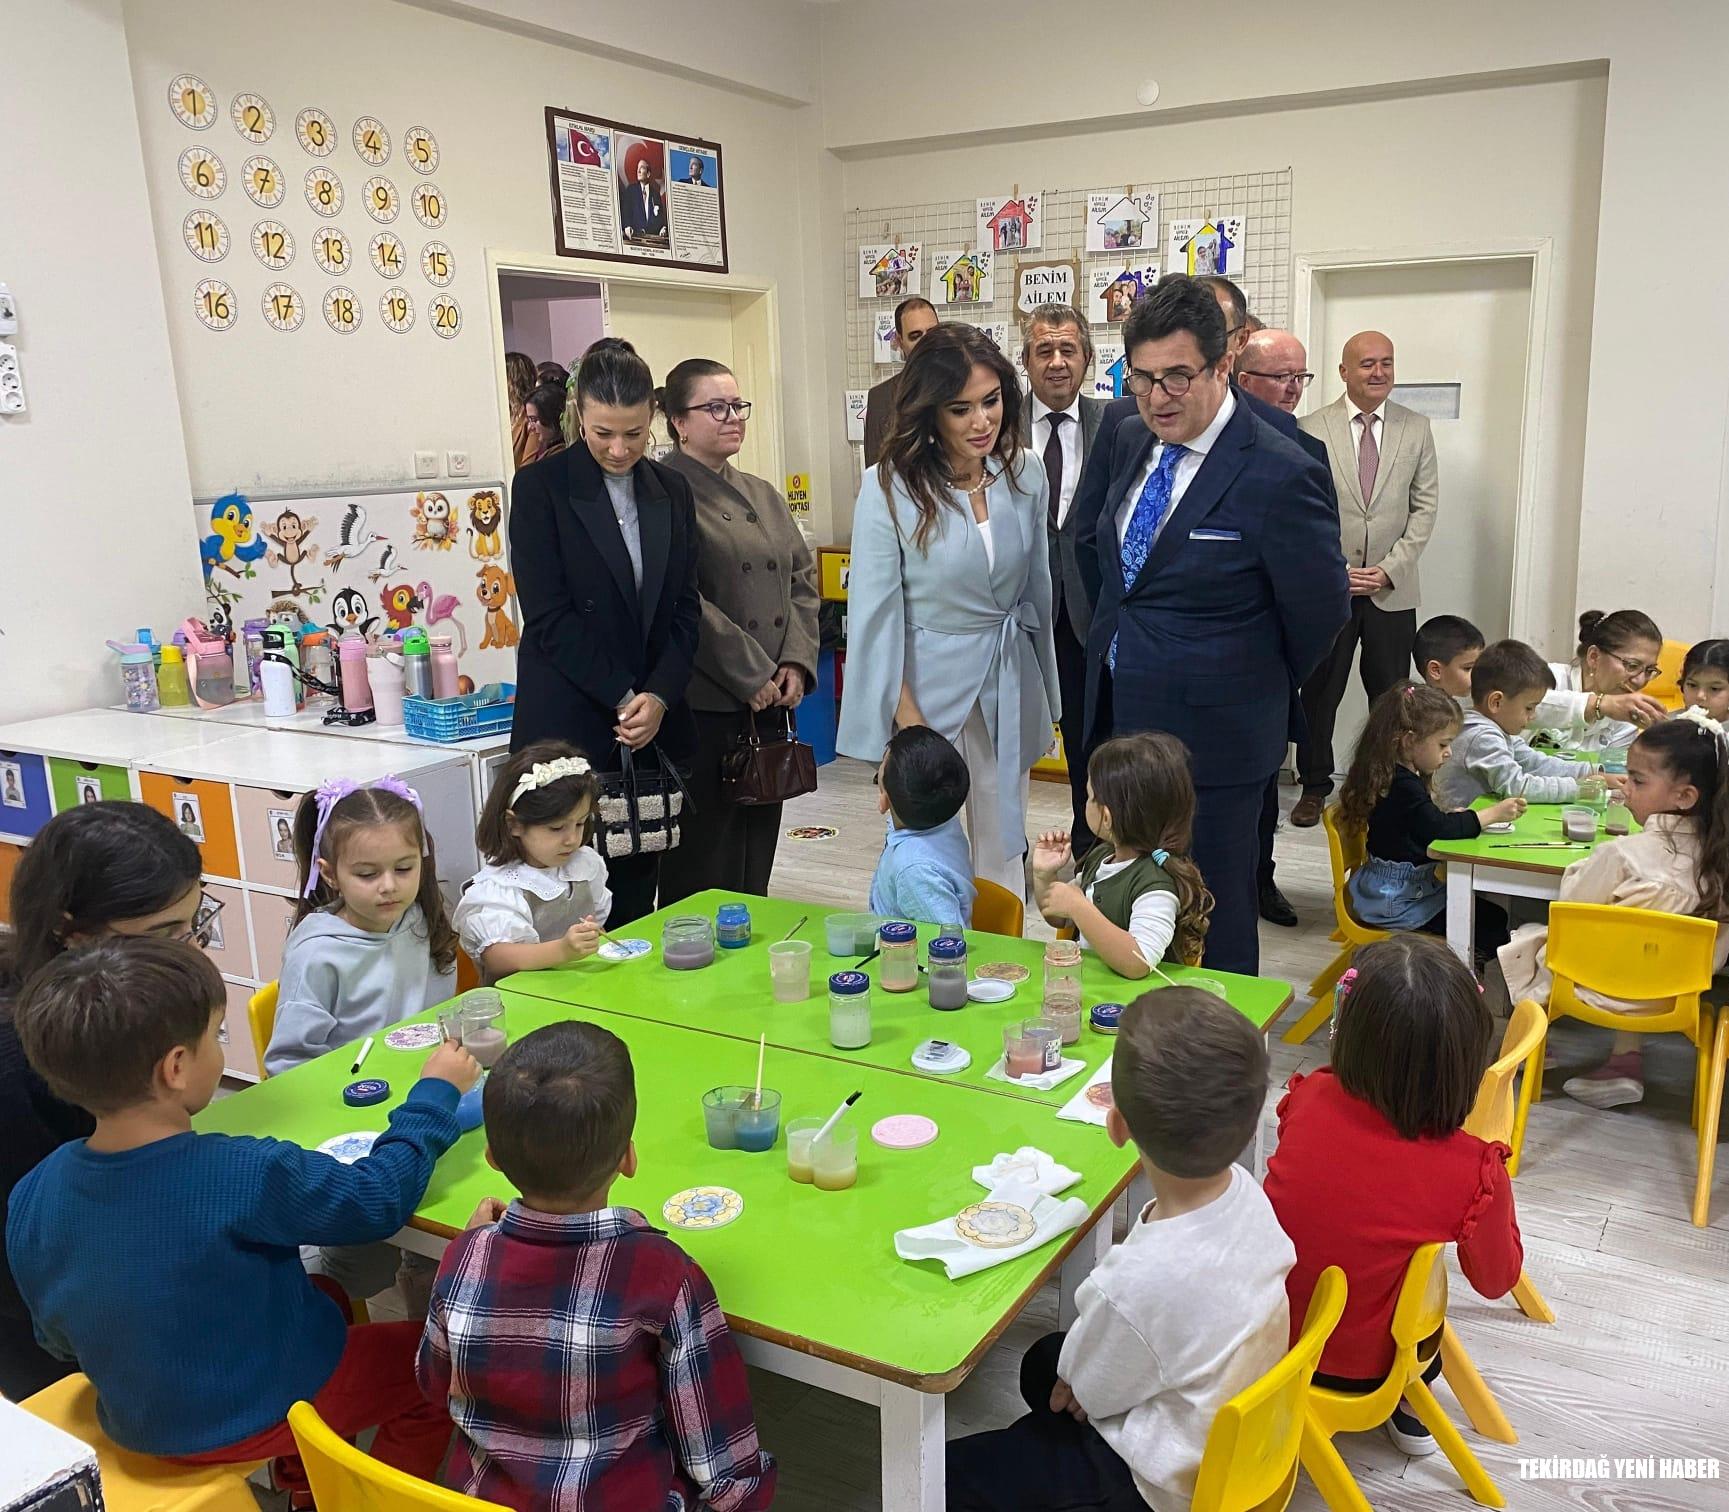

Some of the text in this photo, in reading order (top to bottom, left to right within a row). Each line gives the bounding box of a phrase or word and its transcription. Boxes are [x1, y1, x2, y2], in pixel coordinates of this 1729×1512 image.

[187, 89, 197, 117] 1
[247, 105, 262, 134] 2
[310, 120, 325, 147] 3
[365, 130, 381, 155] 4
[416, 138, 429, 163] 5
[196, 159, 210, 188] 6
[257, 167, 270, 194] 7
[318, 180, 332, 206] 8
[376, 186, 388, 210] 9
[419, 193, 440, 219] 10
[194, 221, 215, 250] 11
[261, 231, 286, 260] 12
[322, 237, 344, 265] 13
[377, 242, 402, 268] 14
[428, 251, 447, 276] 15
[1024, 270, 1067, 285] BENİM
[203, 291, 230, 319] 16
[271, 295, 293, 321] 17
[332, 297, 354, 324] 18
[387, 297, 407, 322] 19
[1024, 290, 1066, 305] AİLEM
[435, 303, 458, 329] 20
